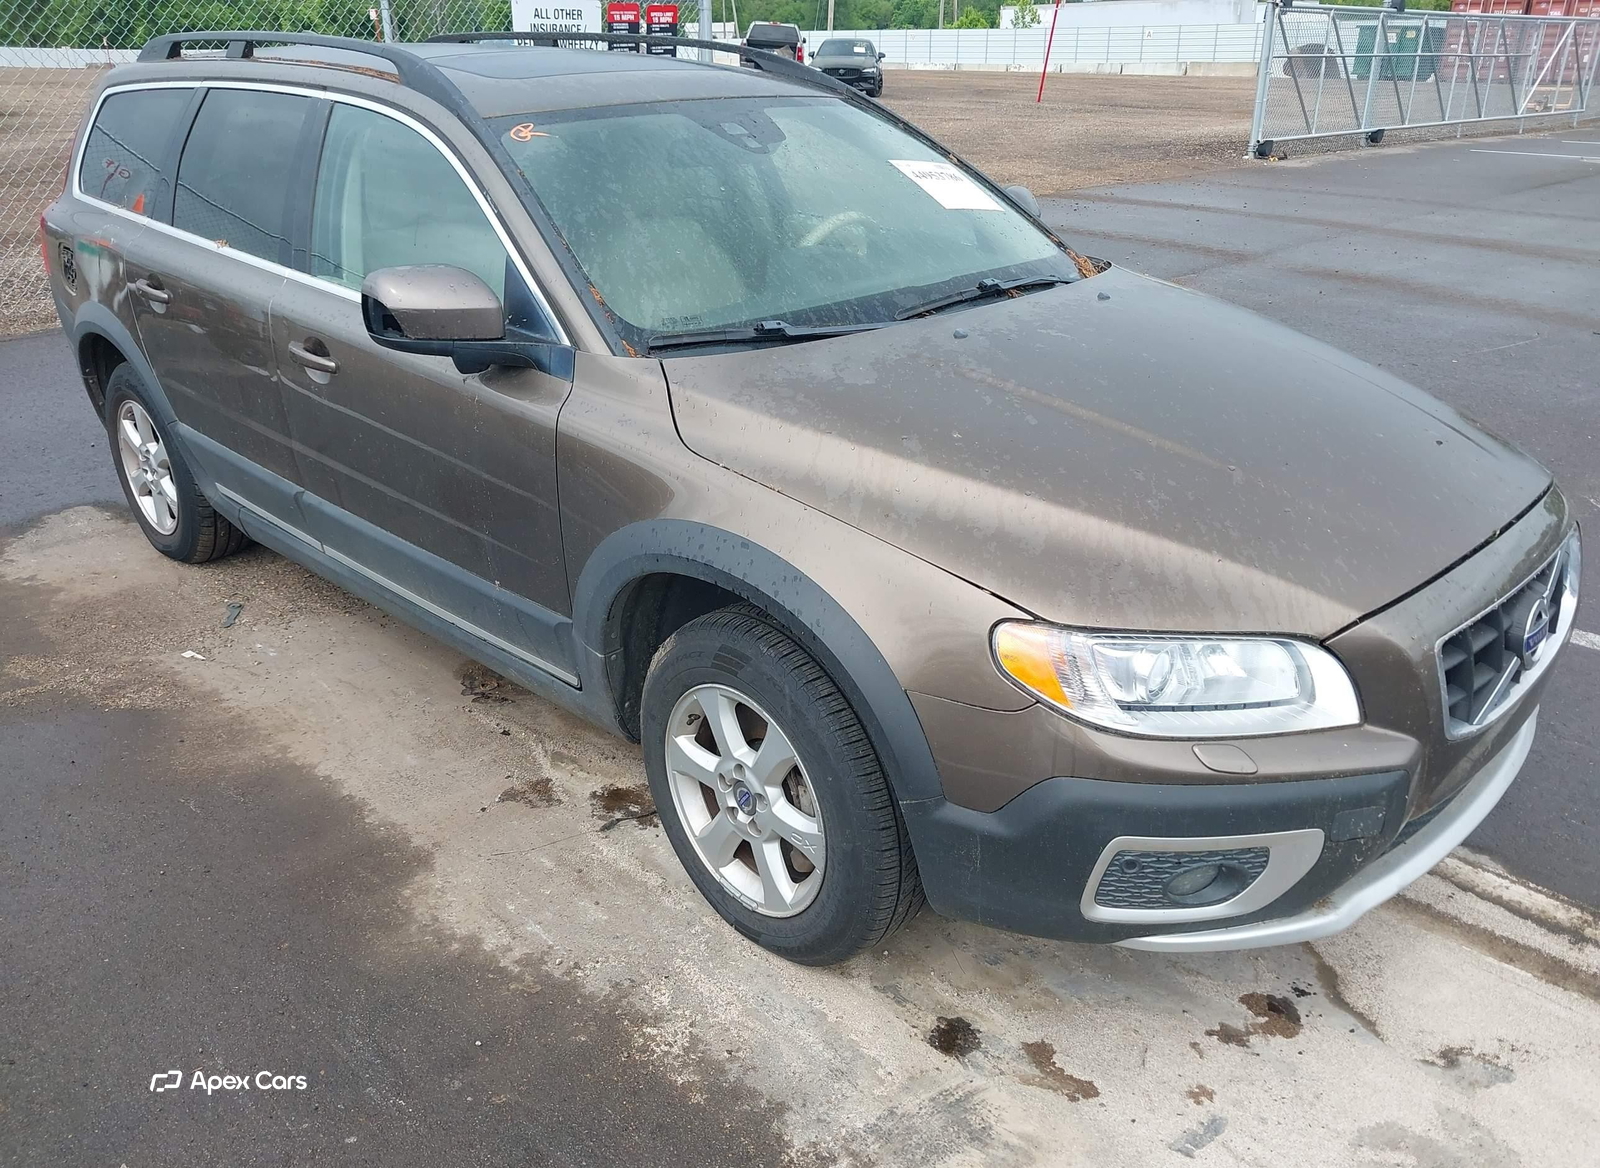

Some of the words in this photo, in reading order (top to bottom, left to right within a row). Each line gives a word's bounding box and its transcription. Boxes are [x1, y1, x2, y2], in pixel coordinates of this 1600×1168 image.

[534, 8, 551, 19] ALL
[553, 8, 583, 20] OTHER
[530, 23, 581, 33] INSURANCE
